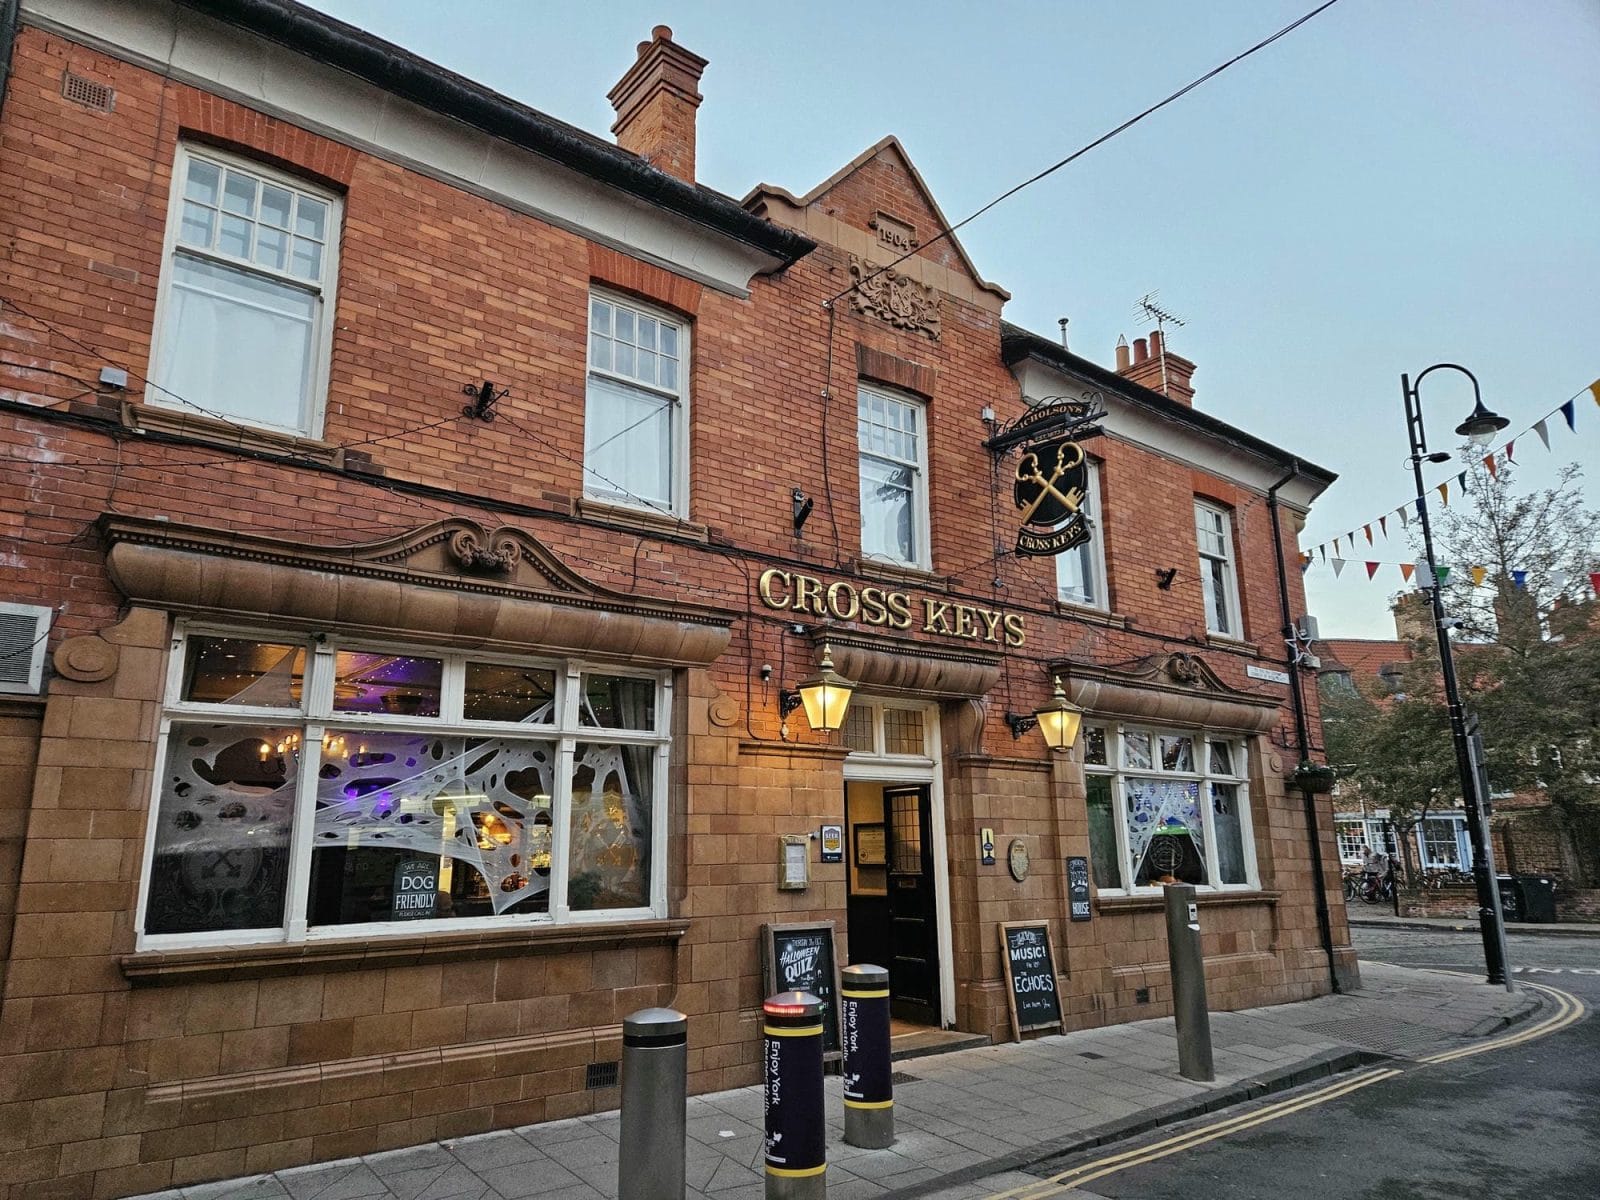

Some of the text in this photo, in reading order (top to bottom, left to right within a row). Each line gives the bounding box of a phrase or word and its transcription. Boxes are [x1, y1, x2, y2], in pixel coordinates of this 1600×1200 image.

[880, 229, 909, 250] 1904
[1019, 521, 1082, 551] CROSS KEYS
[759, 568, 1026, 647] CROSS KEYS
[401, 875, 434, 890] DOG
[395, 893, 436, 910] FRIENDLY
[1072, 901, 1090, 915] HOUSE
[779, 945, 821, 969] HALLOWEEN
[1010, 945, 1046, 961] MUSIC!
[784, 956, 814, 983] QUIZ
[1014, 974, 1054, 993] ECHOES
[849, 1000, 858, 1030] Enjoy
[850, 1031, 859, 1053] York
[771, 1040, 781, 1106] Enjoy York
